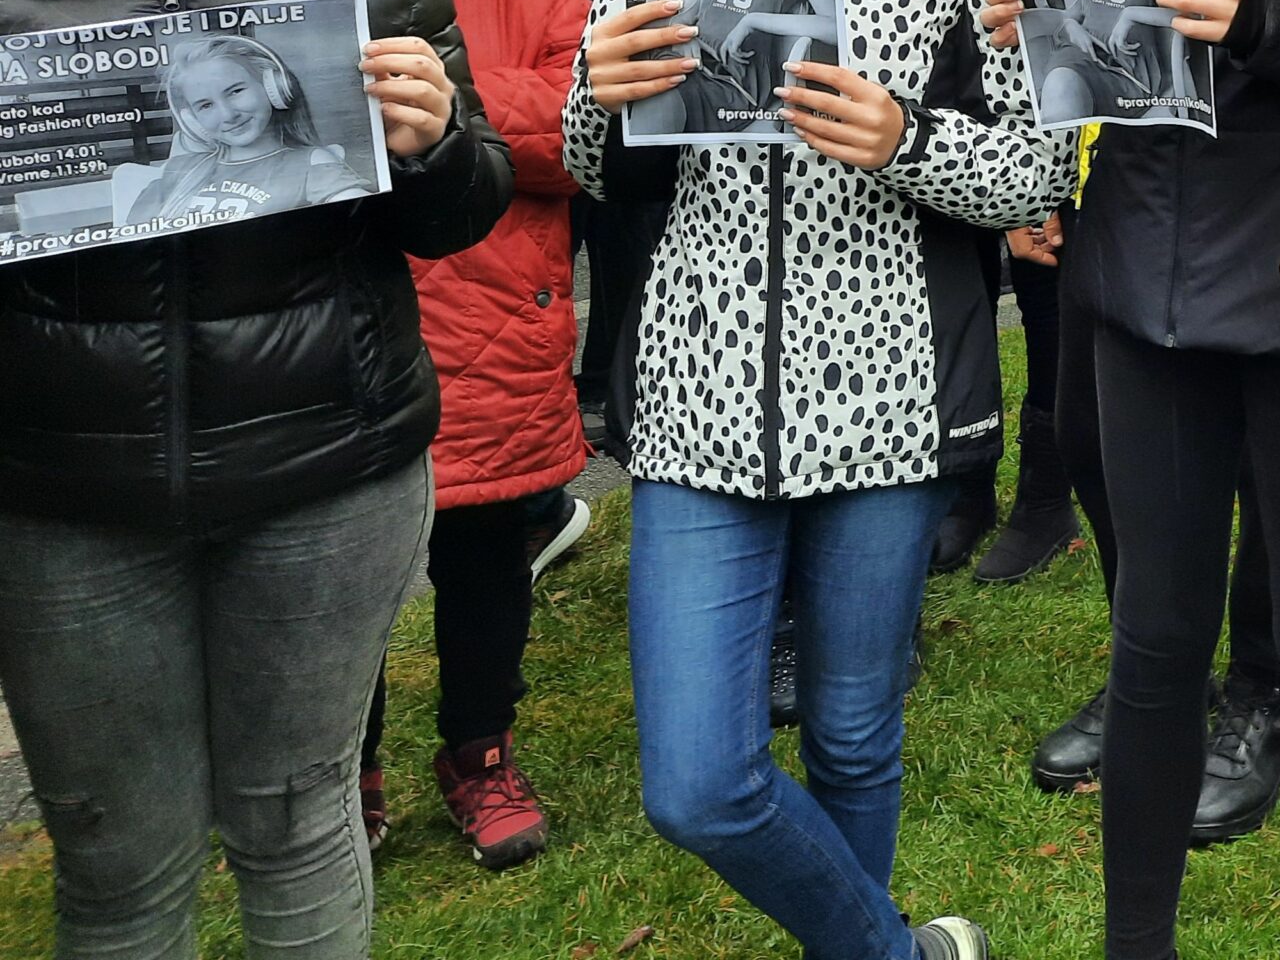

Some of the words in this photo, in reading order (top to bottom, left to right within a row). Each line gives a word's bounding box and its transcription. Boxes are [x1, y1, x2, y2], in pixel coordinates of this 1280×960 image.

[0, 36, 47, 52] OJ
[58, 21, 153, 45] UBICA
[161, 15, 192, 35] JE
[201, 12, 209, 31] I
[218, 5, 305, 29] DALJE
[0, 58, 28, 82] A
[37, 45, 169, 78] SLOBODI
[19, 118, 81, 135] Fashion
[85, 108, 142, 128] (Plaza)
[32, 102, 65, 117] kod
[56, 145, 104, 160] 14.01.
[56, 160, 108, 177] 11:59h
[220, 180, 271, 205] CHANGE
